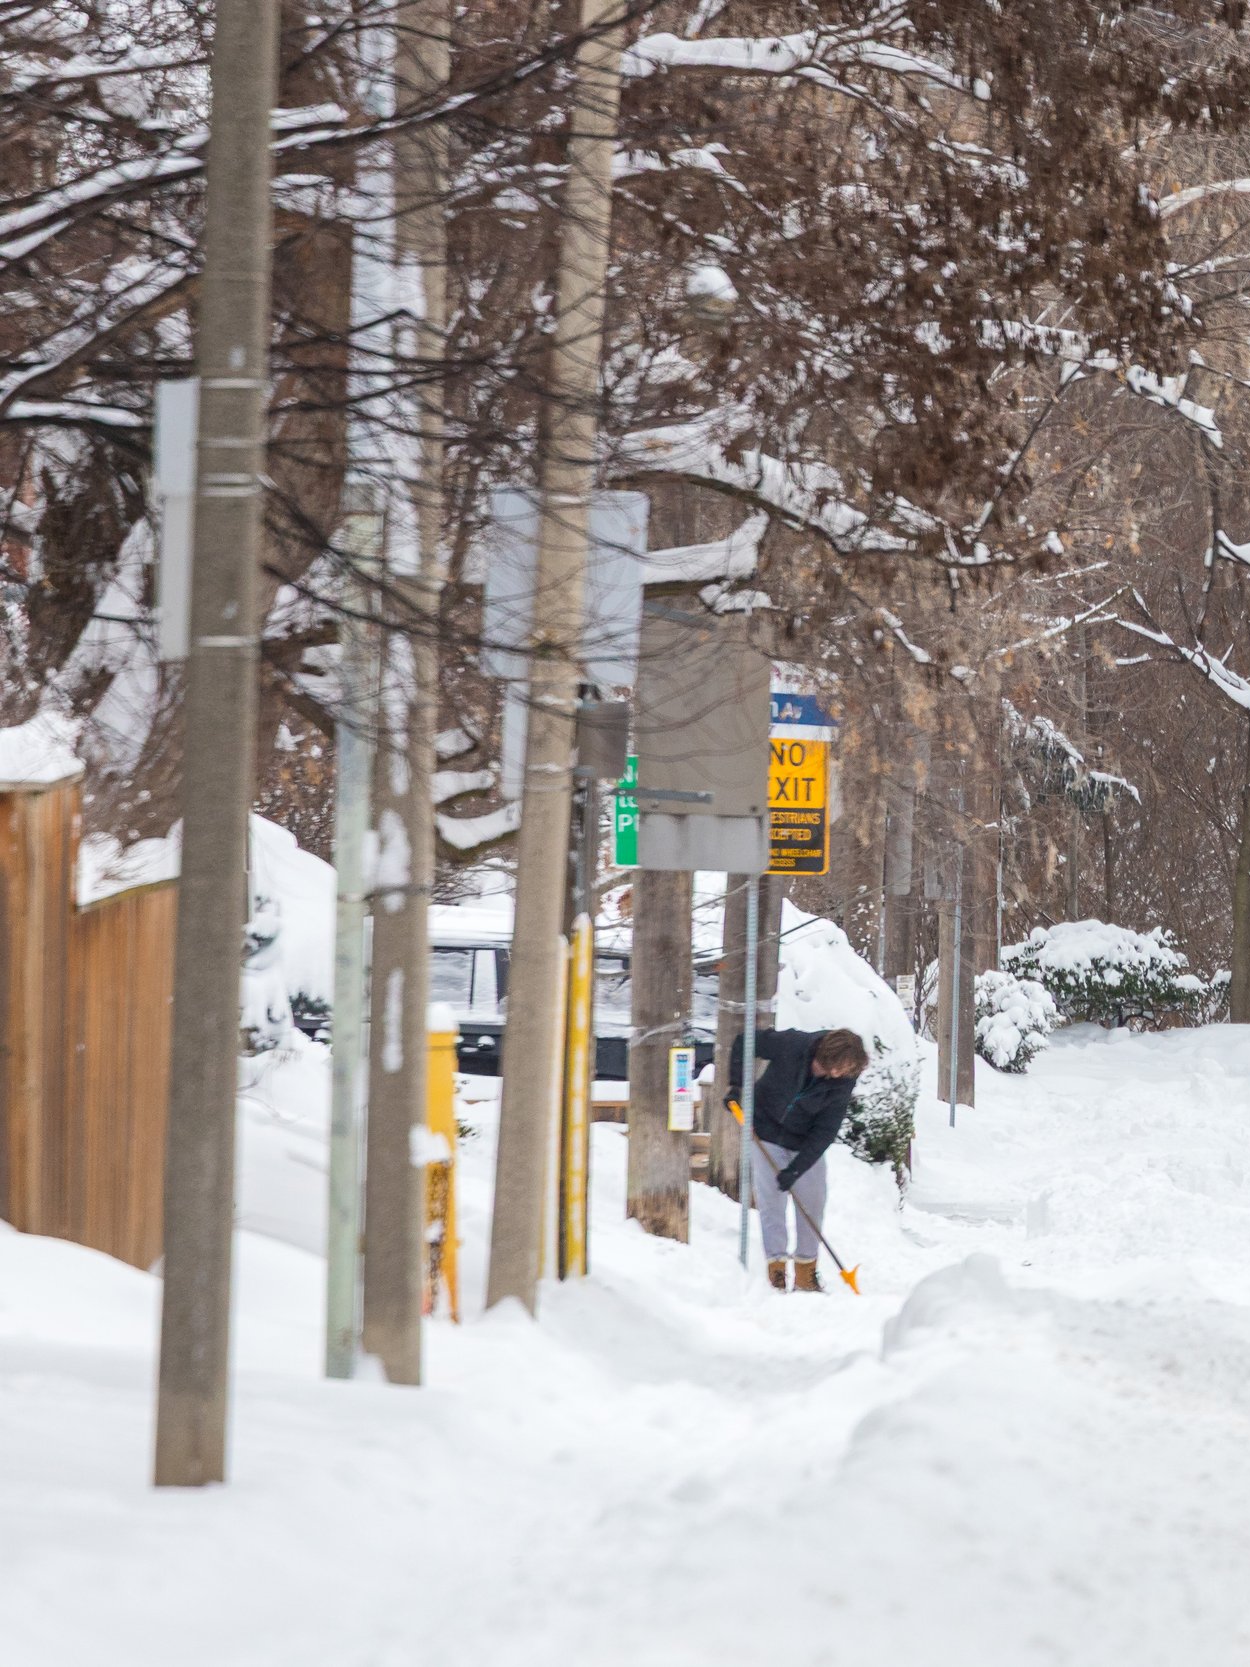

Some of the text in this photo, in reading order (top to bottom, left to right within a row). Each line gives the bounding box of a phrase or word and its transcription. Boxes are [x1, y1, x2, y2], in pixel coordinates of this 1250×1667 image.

[769, 742, 805, 766] NO
[769, 776, 816, 801] XIT
[768, 812, 821, 825] ESTRIANS
